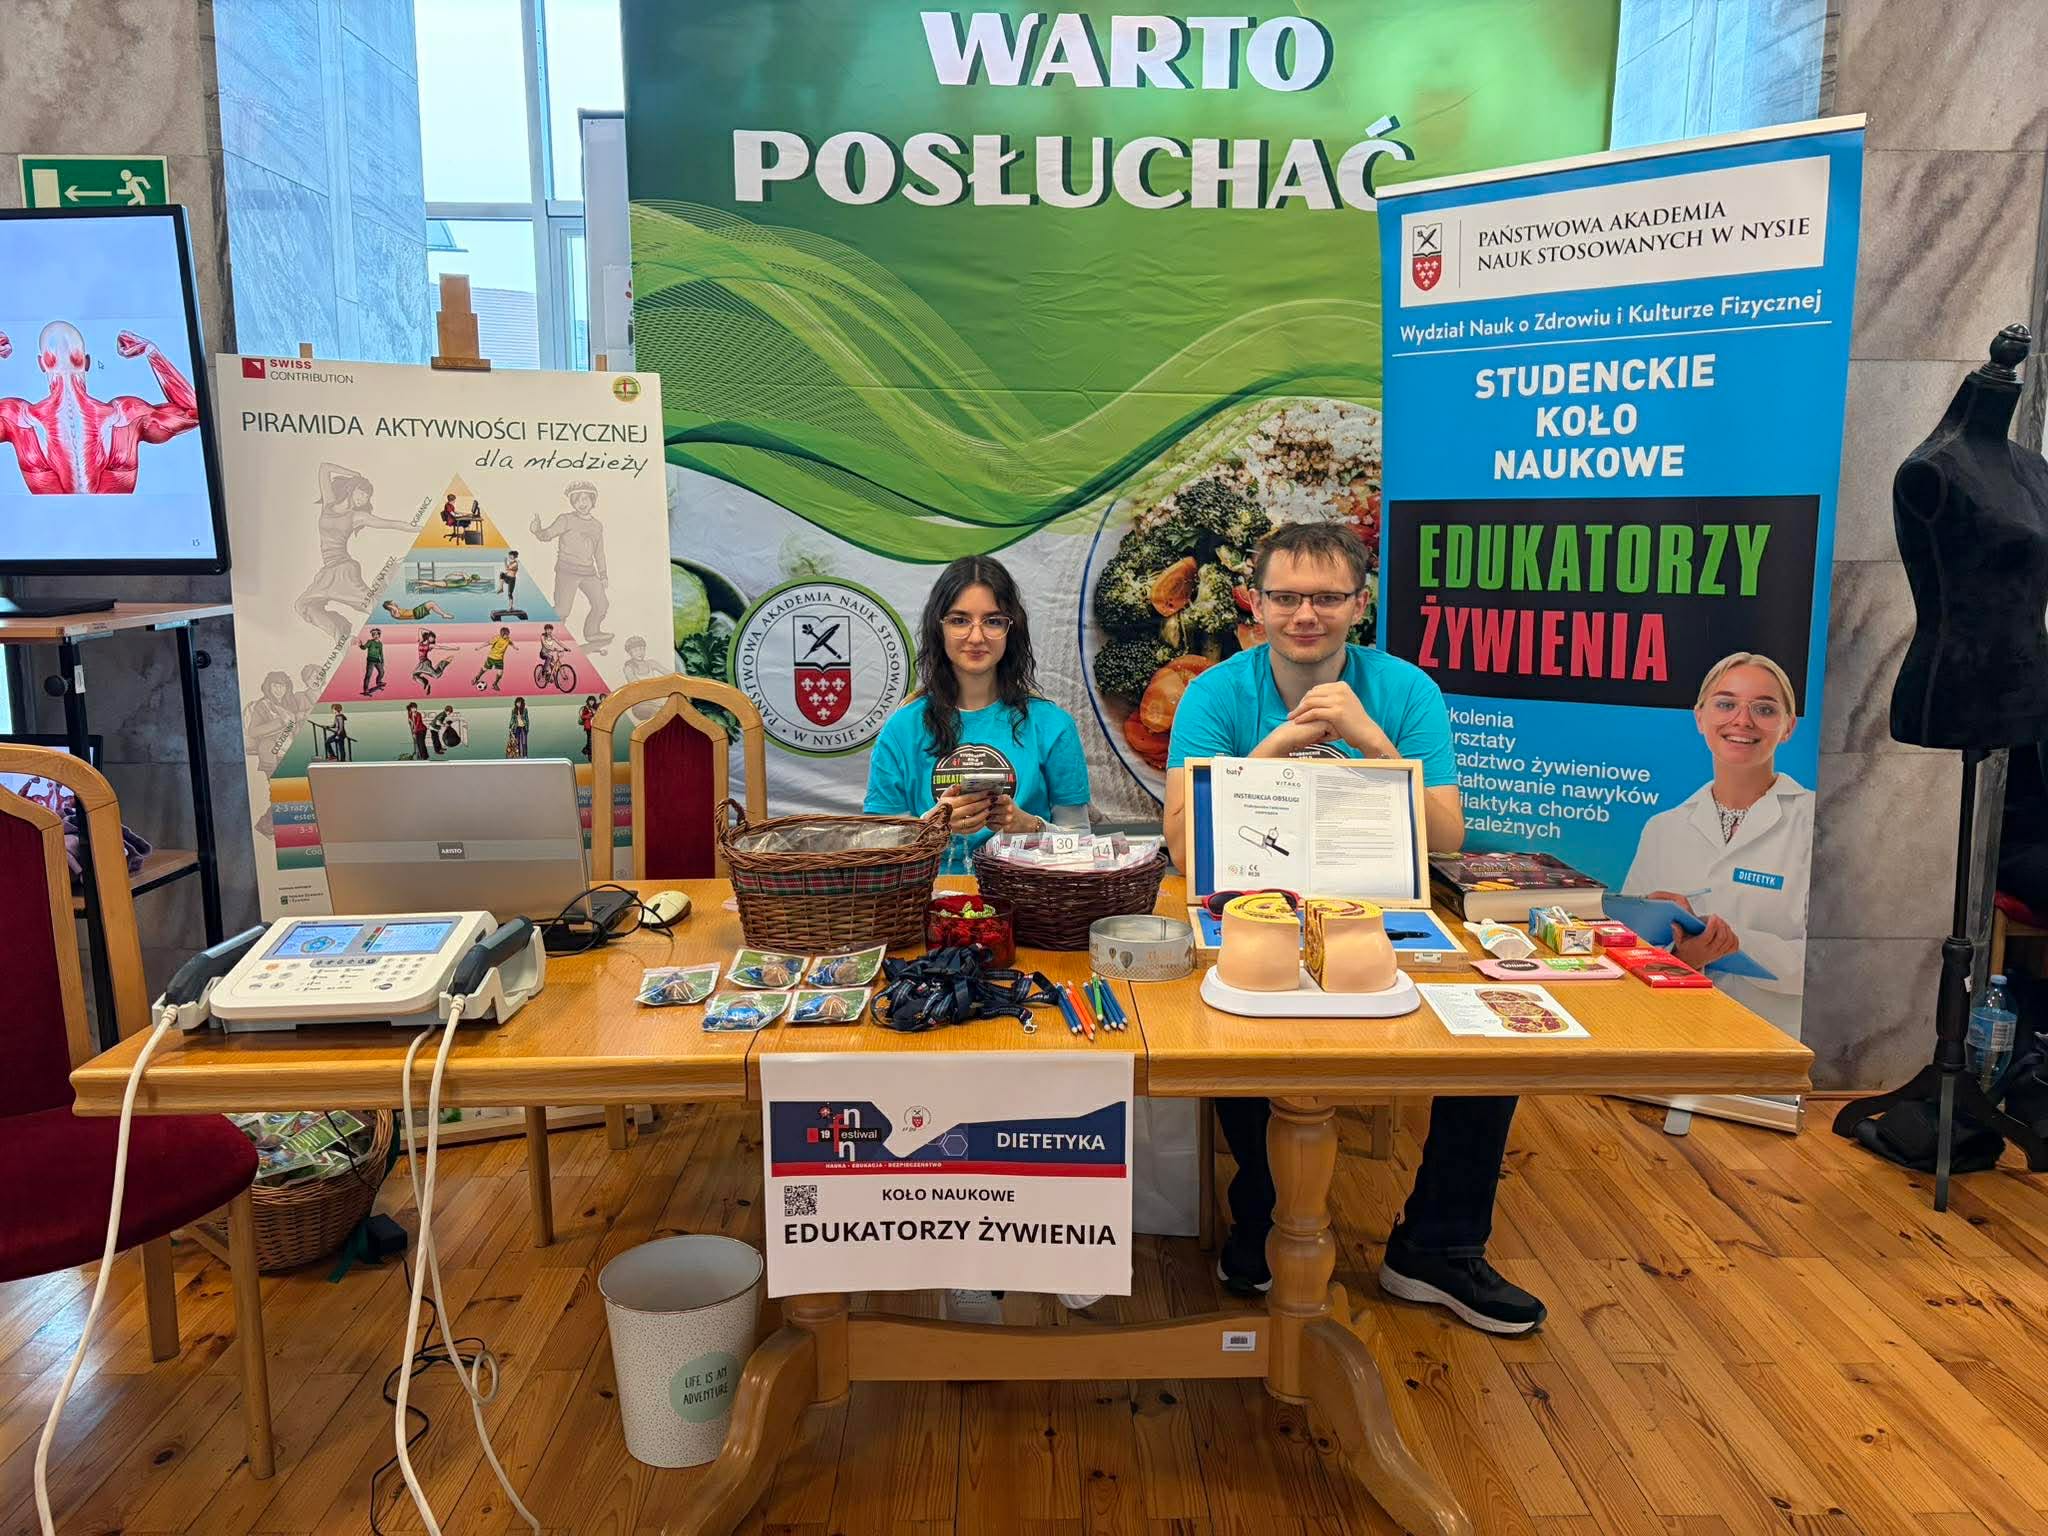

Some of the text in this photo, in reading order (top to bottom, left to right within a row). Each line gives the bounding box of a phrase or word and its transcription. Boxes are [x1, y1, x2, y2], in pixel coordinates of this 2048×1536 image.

[920, 11, 1331, 92] WARTO
[732, 115, 1414, 211] POSŁUCHAĆ
[1478, 200, 1726, 248] PAŃSTWOWA AKADEMIA
[1478, 216, 1811, 272] NAUK STOSOWANYCH W NYSIE
[1400, 289, 1823, 346] Wydział Nauk o Zdrowiu i Kulturze Fizycznej
[269, 358, 313, 370] SWISS
[270, 371, 354, 384] CONTRIBUTION
[1474, 353, 1717, 399] STUDENCKIE
[241, 411, 648, 444] PIRAMIDA AKTYWNOŚCI FIZYCZNEJ
[1536, 402, 1638, 438] KOŁO
[475, 448, 649, 479] dla młodzieży
[1493, 444, 1685, 480] NAUKOWE
[1419, 524, 1771, 596] EDUKATORZY
[1418, 596, 1667, 681] ŻYWIENIA
[742, 591, 900, 729] PAŃSTWOWA AKADEMIA NAUK STOSOWANYCH
[1447, 706, 1514, 729] kolenia
[794, 729, 857, 746] W NYSIE
[1451, 731, 1517, 753] rsztaty
[1454, 752, 1651, 783] adztwo żywieniowe
[1456, 772, 1660, 806] tałtowanie nawyków
[1459, 791, 1610, 823] ilaktyka chorób
[1464, 815, 1561, 840] zależnych
[1056, 838, 1073, 850] 30
[1094, 844, 1110, 857] 14
[1738, 871, 1776, 886] DIETETYK
[820, 1129, 831, 1139] 19
[997, 1131, 1106, 1151] DIETETYKA
[882, 1188, 1015, 1203] KOŁO NAUKOWE
[784, 1215, 1117, 1246] EDUKATORZY ŻYWIENIA
[683, 1382, 728, 1404] ADVENTURE
[685, 1374, 702, 1388] LIFE
[706, 1372, 714, 1384] IS
